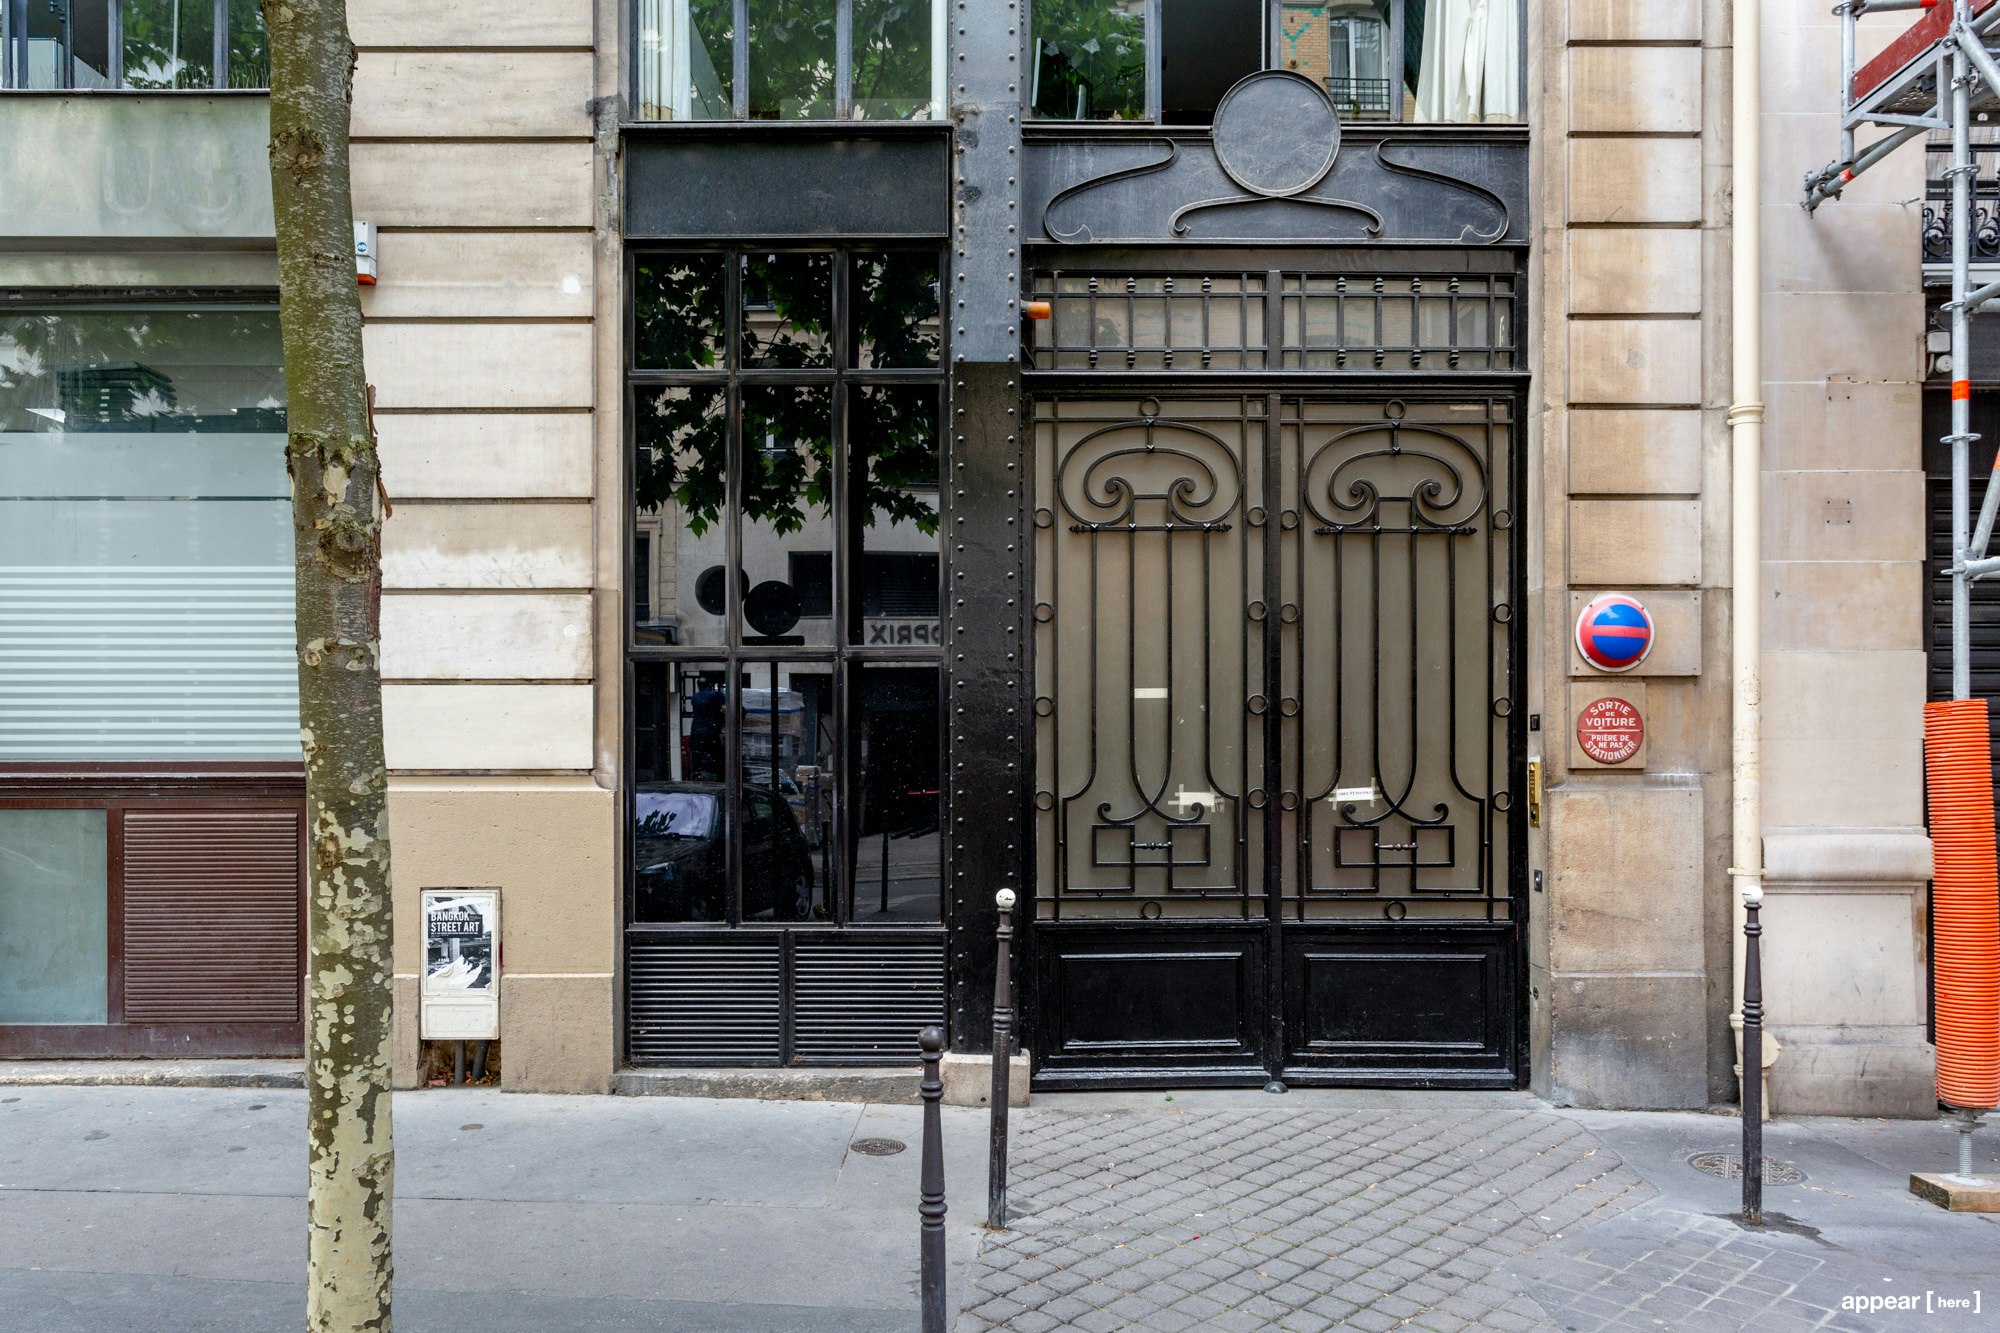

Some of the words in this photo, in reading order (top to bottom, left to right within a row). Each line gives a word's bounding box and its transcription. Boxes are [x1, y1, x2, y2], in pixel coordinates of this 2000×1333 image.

[1590, 701, 1631, 716] SORTIE
[1585, 717, 1636, 727] VOITURE
[1585, 741, 1636, 760] STATIONNER
[430, 911, 470, 921] BANGKOK
[430, 922, 463, 932] STREET
[463, 922, 480, 932] ART
